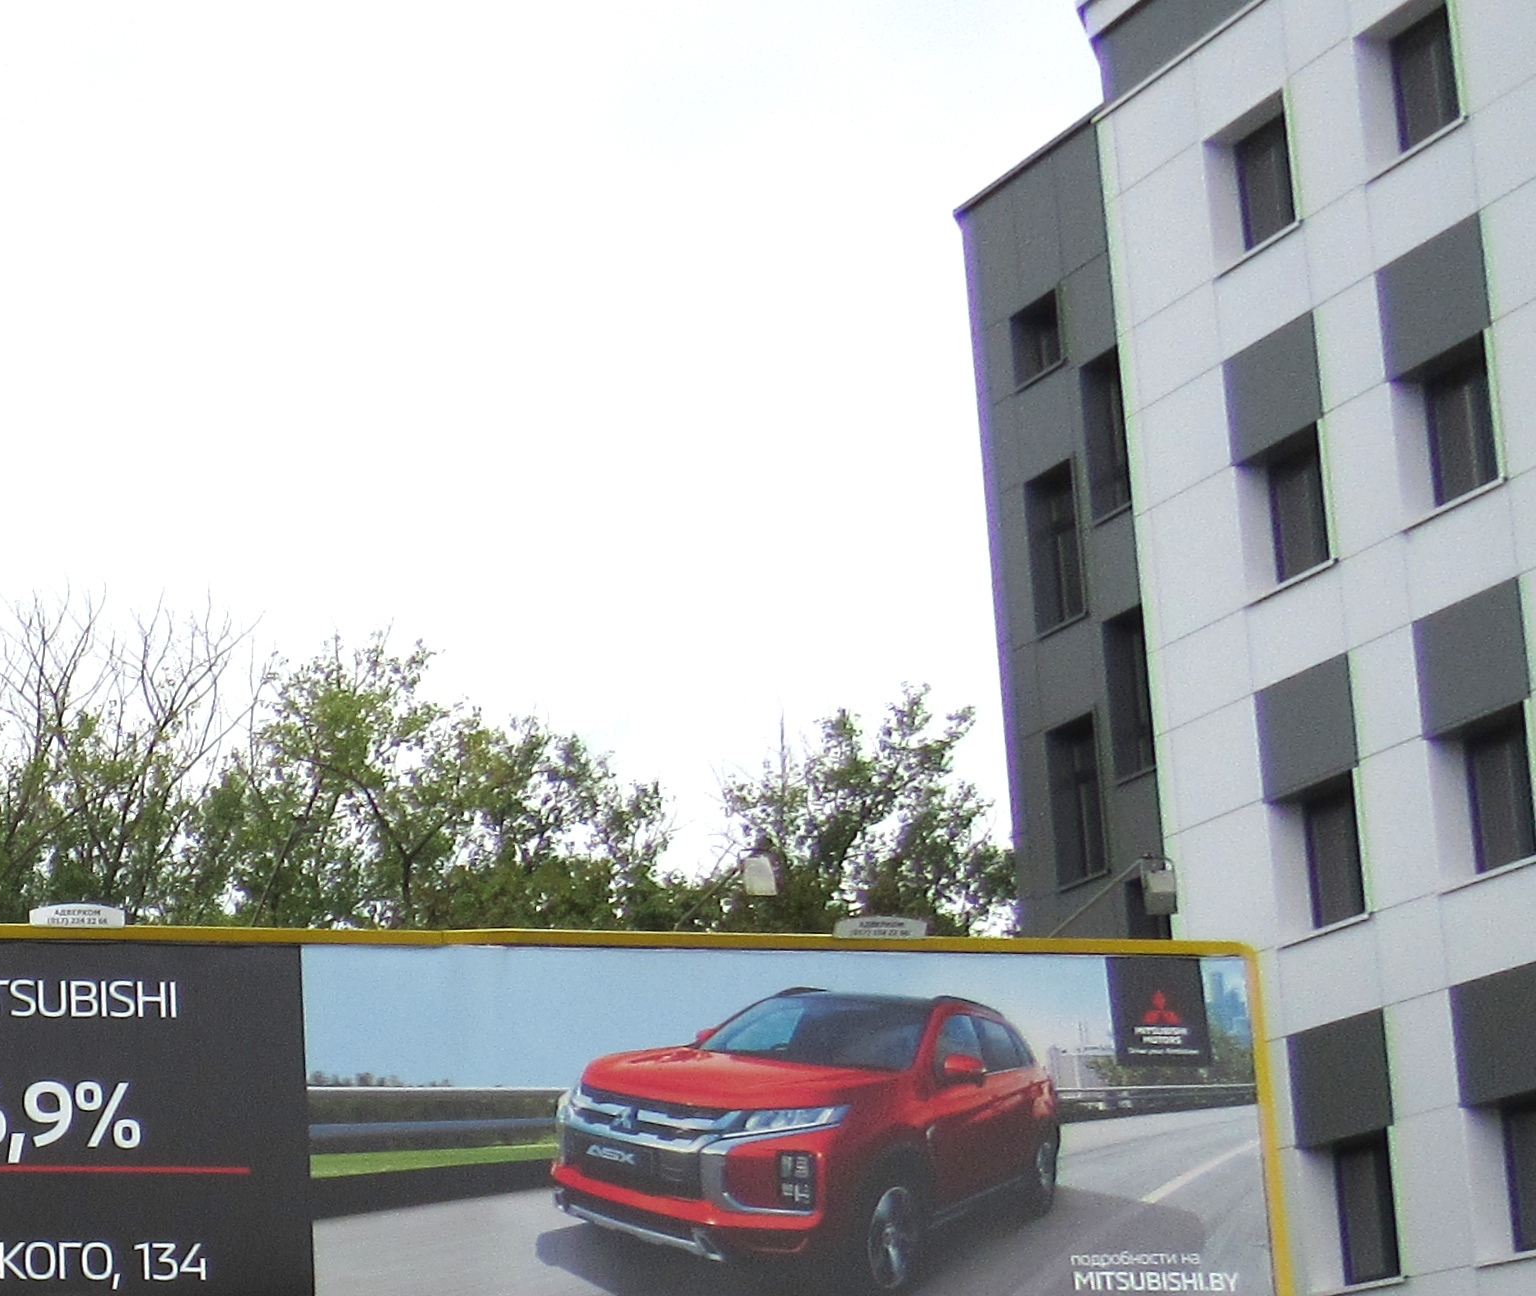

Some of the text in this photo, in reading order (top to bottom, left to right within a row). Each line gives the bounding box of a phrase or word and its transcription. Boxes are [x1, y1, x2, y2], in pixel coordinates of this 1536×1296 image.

[586, 1143, 638, 1166] ASX
[134, 1242, 207, 1282] 134
[1071, 1251, 1201, 1268] подробности на
[1073, 1271, 1239, 1292] MITSUBISHI.BY
